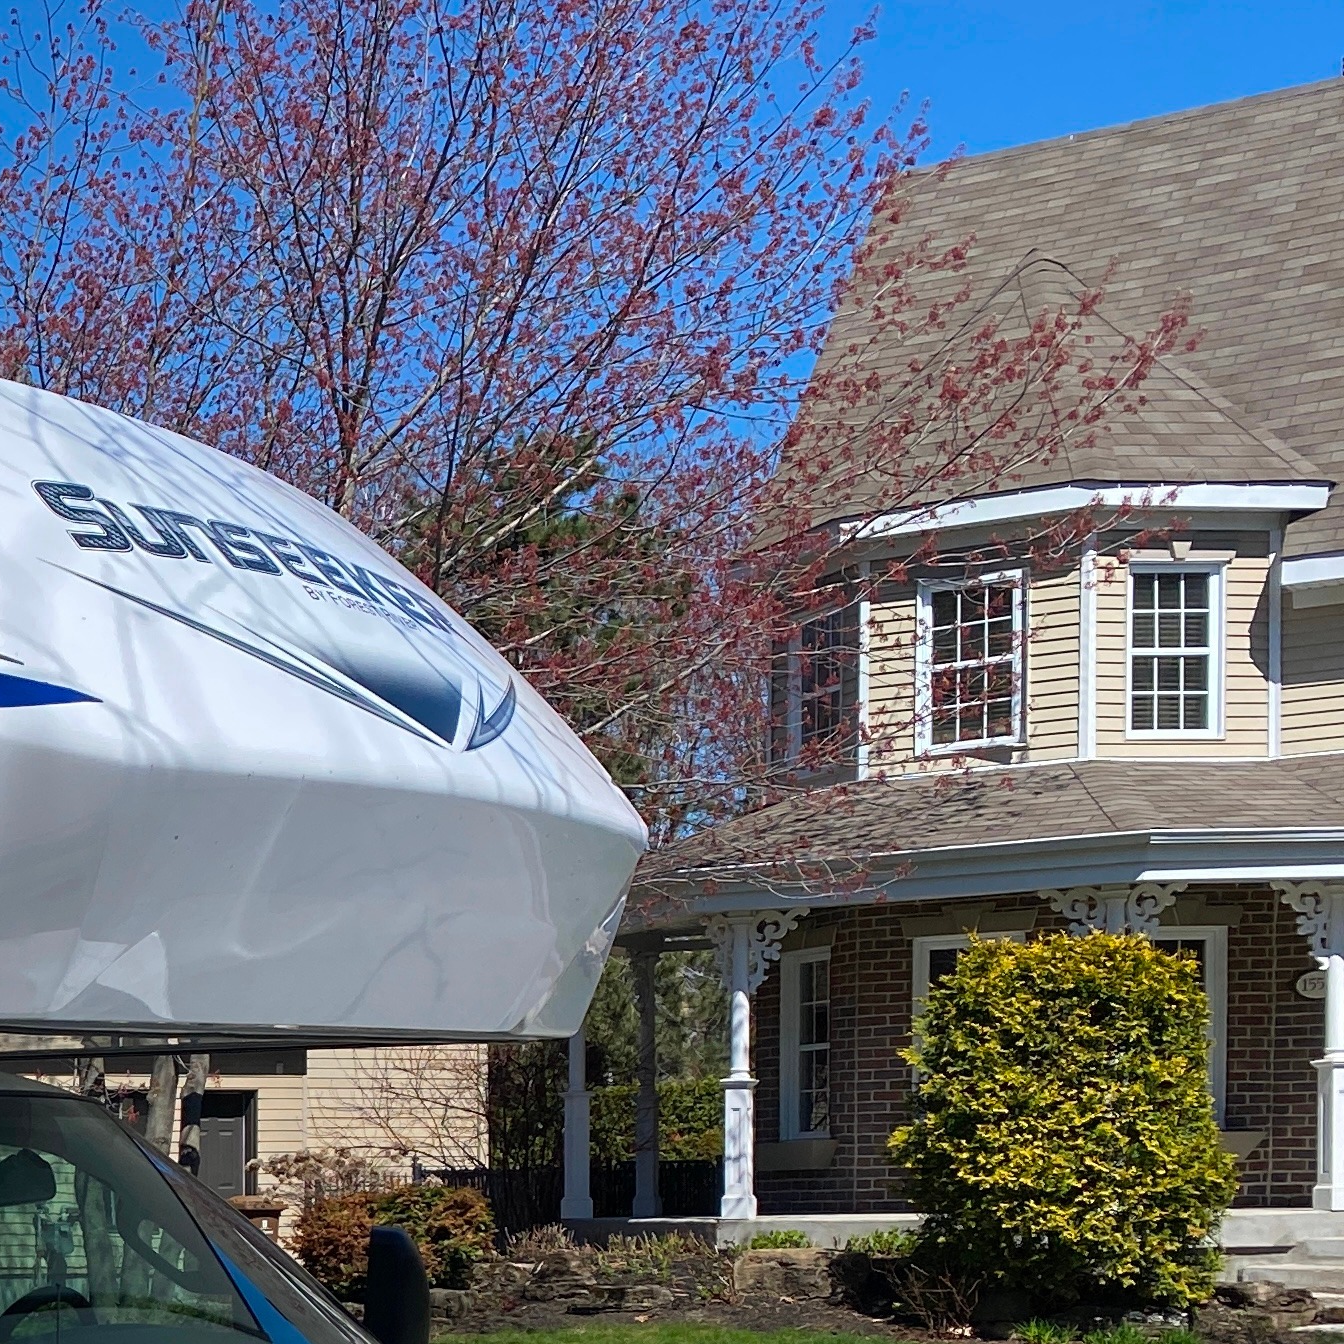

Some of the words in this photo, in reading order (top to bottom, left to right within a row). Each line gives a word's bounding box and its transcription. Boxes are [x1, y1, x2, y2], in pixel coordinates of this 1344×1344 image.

[30, 479, 454, 634] SUNSEEKER
[303, 584, 327, 602] BY
[326, 590, 382, 617] FOREST
